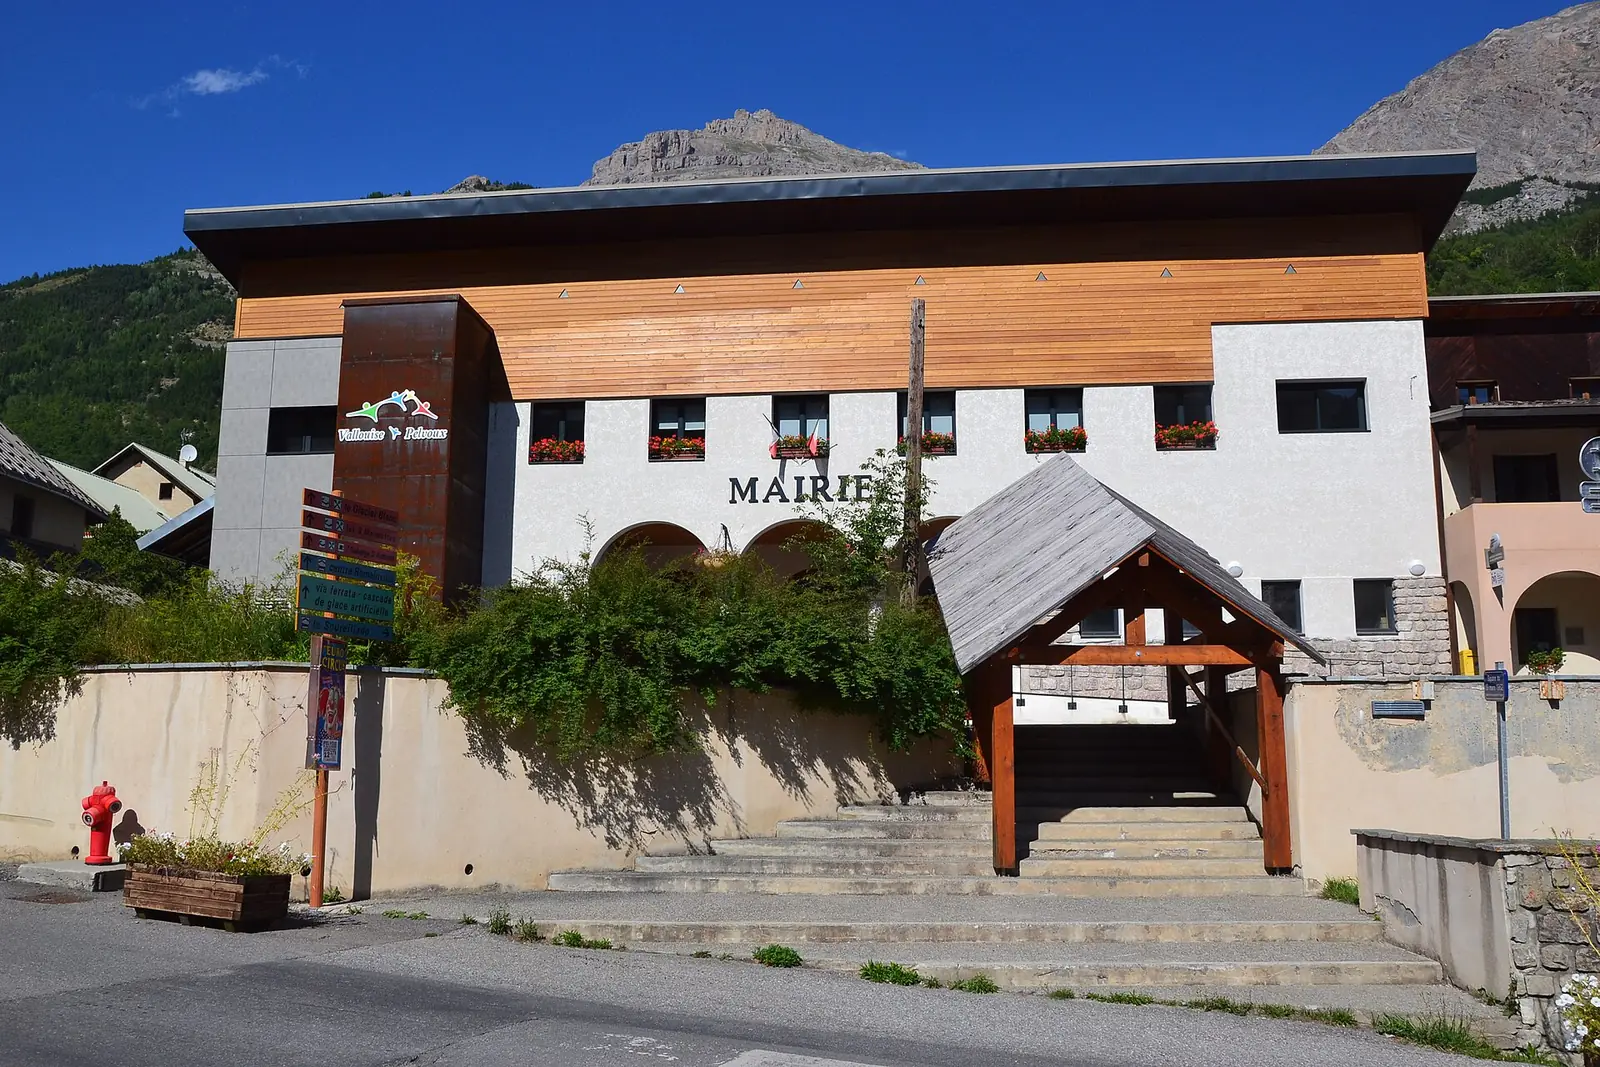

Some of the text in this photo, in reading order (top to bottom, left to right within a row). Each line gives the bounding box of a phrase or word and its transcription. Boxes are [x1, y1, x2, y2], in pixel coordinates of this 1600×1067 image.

[338, 426, 448, 442] Vallouise Pelvoux
[728, 474, 874, 504] MAIRIE
[315, 583, 327, 594] via
[330, 585, 356, 598] ferrata
[363, 593, 392, 605] cascade
[315, 596, 389, 617] de glace artificielle
